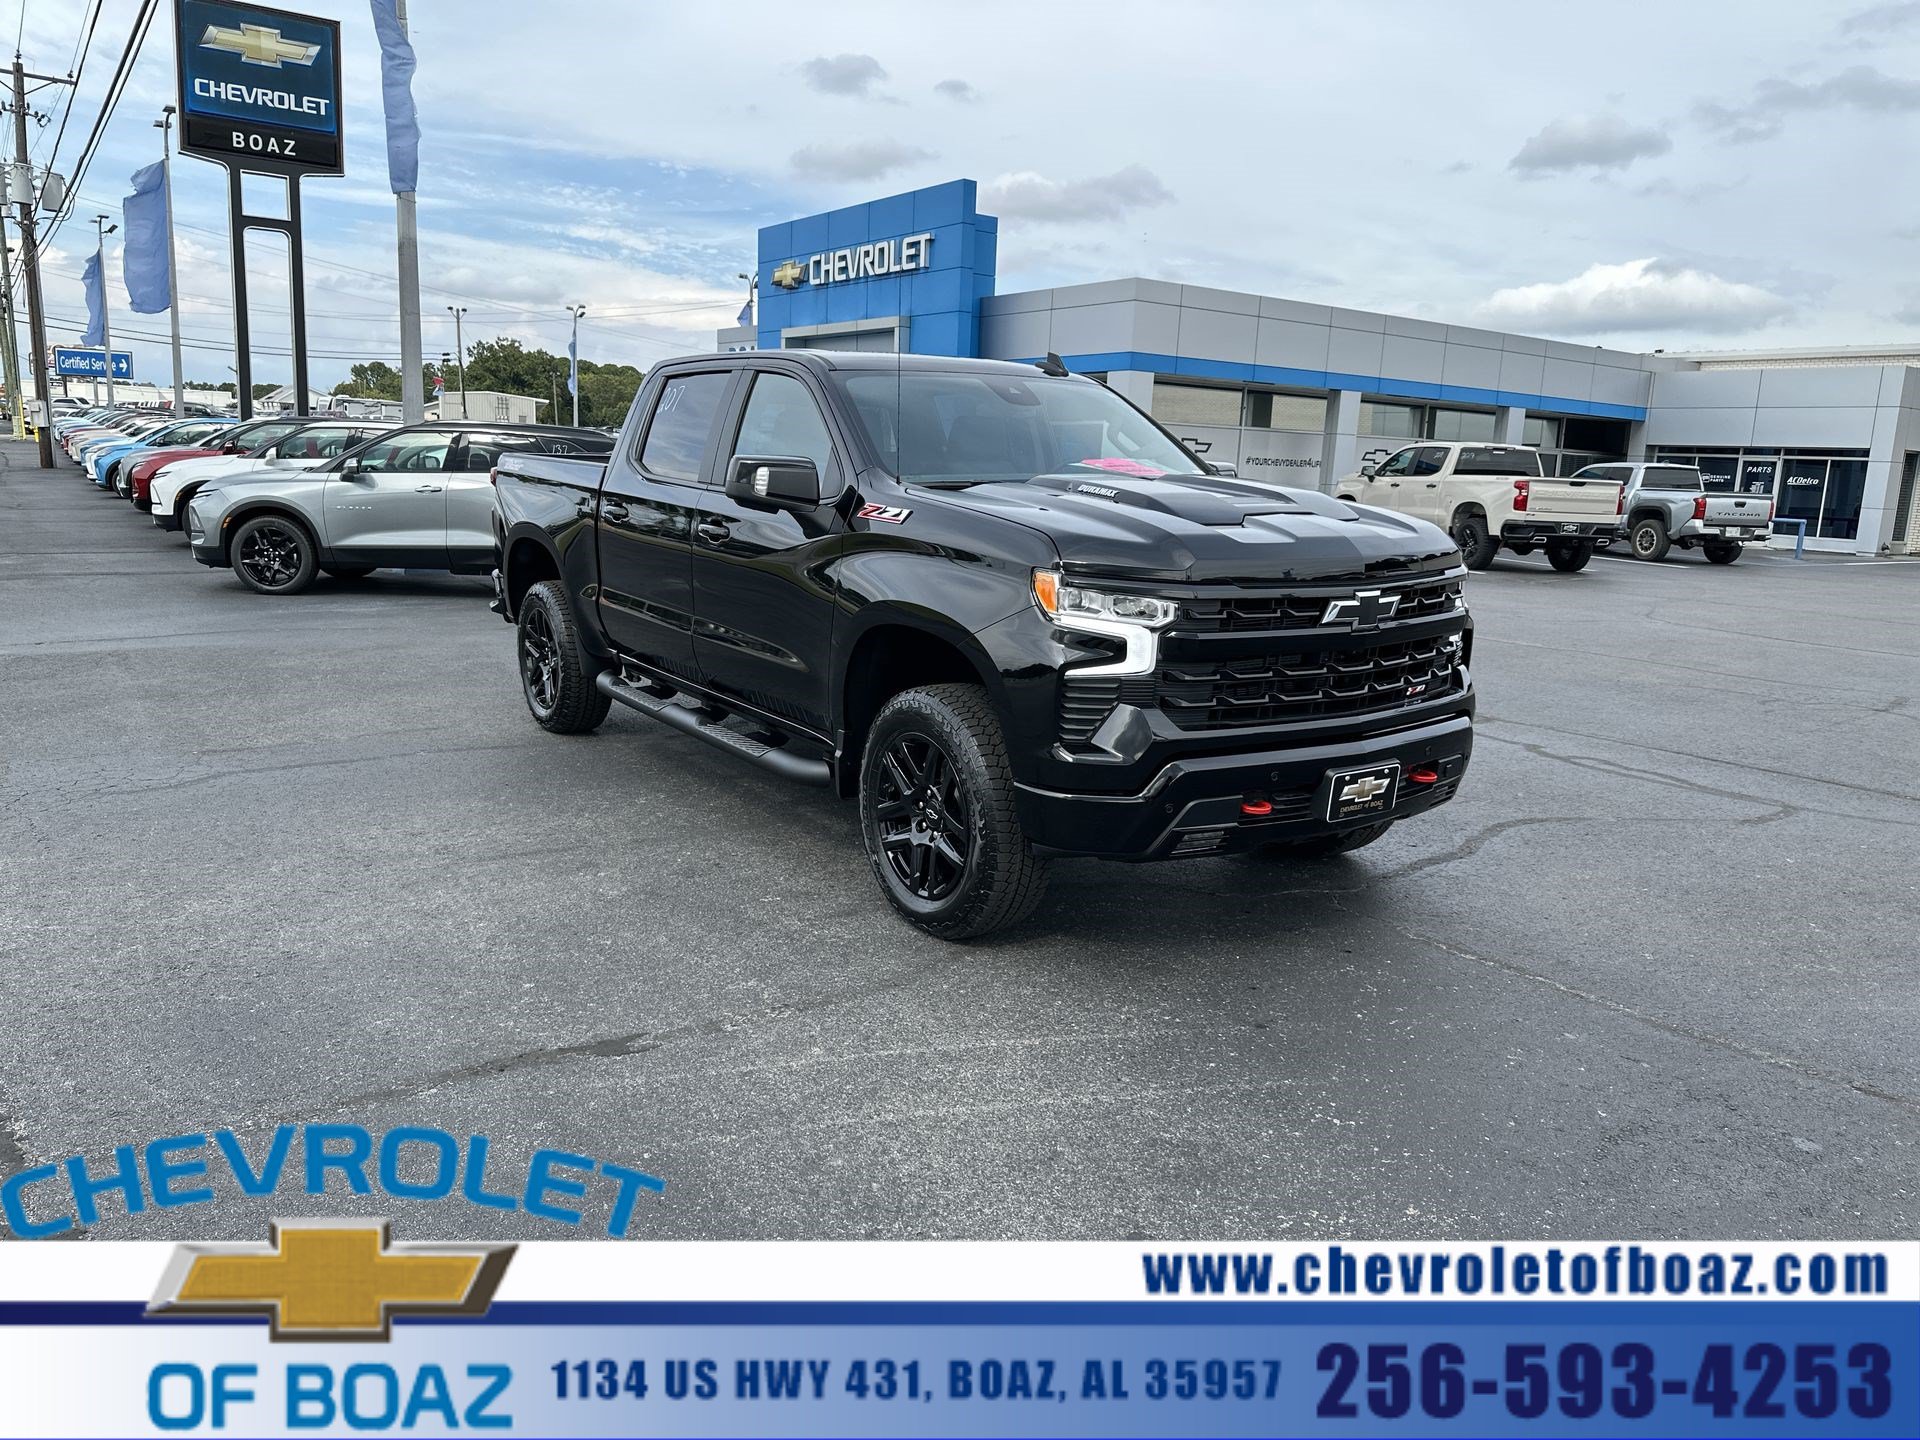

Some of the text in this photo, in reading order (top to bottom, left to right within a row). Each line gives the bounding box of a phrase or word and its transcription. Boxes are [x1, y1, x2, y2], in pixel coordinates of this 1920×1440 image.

[194, 78, 330, 115] CHEVROLET
[232, 131, 297, 156] BOAZ
[809, 232, 935, 286] CHEVROLET
[60, 356, 90, 369] Certified
[1747, 466, 1772, 474] PARTS
[1786, 475, 1820, 486] ACDelco
